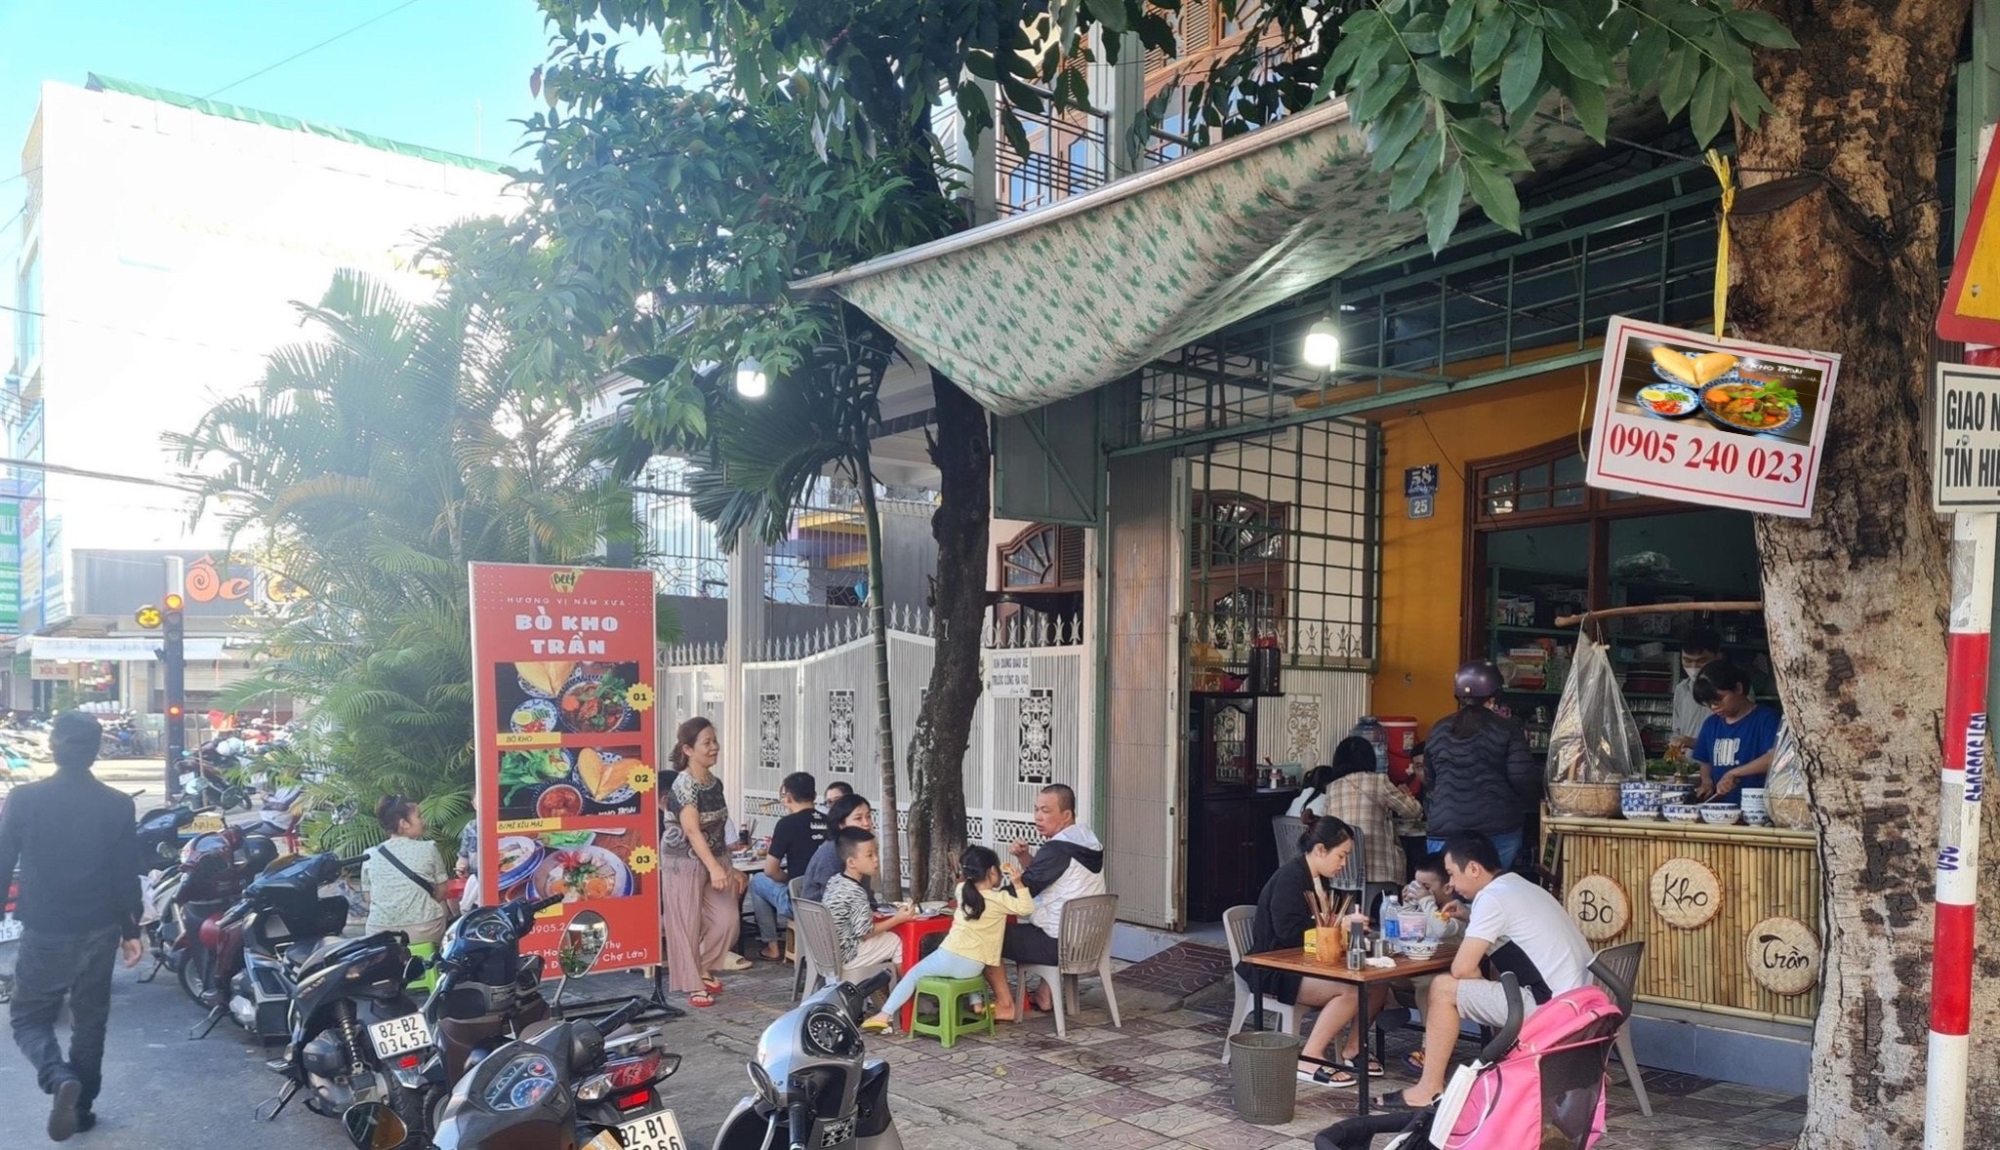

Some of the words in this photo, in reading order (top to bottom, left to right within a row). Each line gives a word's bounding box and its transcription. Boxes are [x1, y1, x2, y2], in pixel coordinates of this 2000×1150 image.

[1946, 389, 1985, 432] GIAO
[1990, 392, 2000, 432] N
[1610, 424, 1678, 463] 0905
[1685, 438, 1739, 474] 240
[1747, 448, 1803, 483] 023
[1945, 439, 1972, 487] TÍN
[1414, 499, 1428, 514] 25
[556, 598, 567, 606] VỊ
[515, 606, 552, 631] BÒ
[562, 615, 618, 631] KHO
[531, 632, 605, 655] TRẦN
[633, 693, 646, 701] 01
[634, 774, 649, 783] 02
[636, 855, 650, 864] 03
[1578, 889, 1614, 924] Bò
[1661, 872, 1709, 915] Kho
[1759, 934, 1809, 969] Trần
[602, 953, 623, 962] Chợ
[627, 948, 648, 960] Lớn)
[378, 1017, 419, 1038] 82-B2
[379, 1030, 429, 1055] 034.52
[619, 1116, 667, 1148] 82-B1
